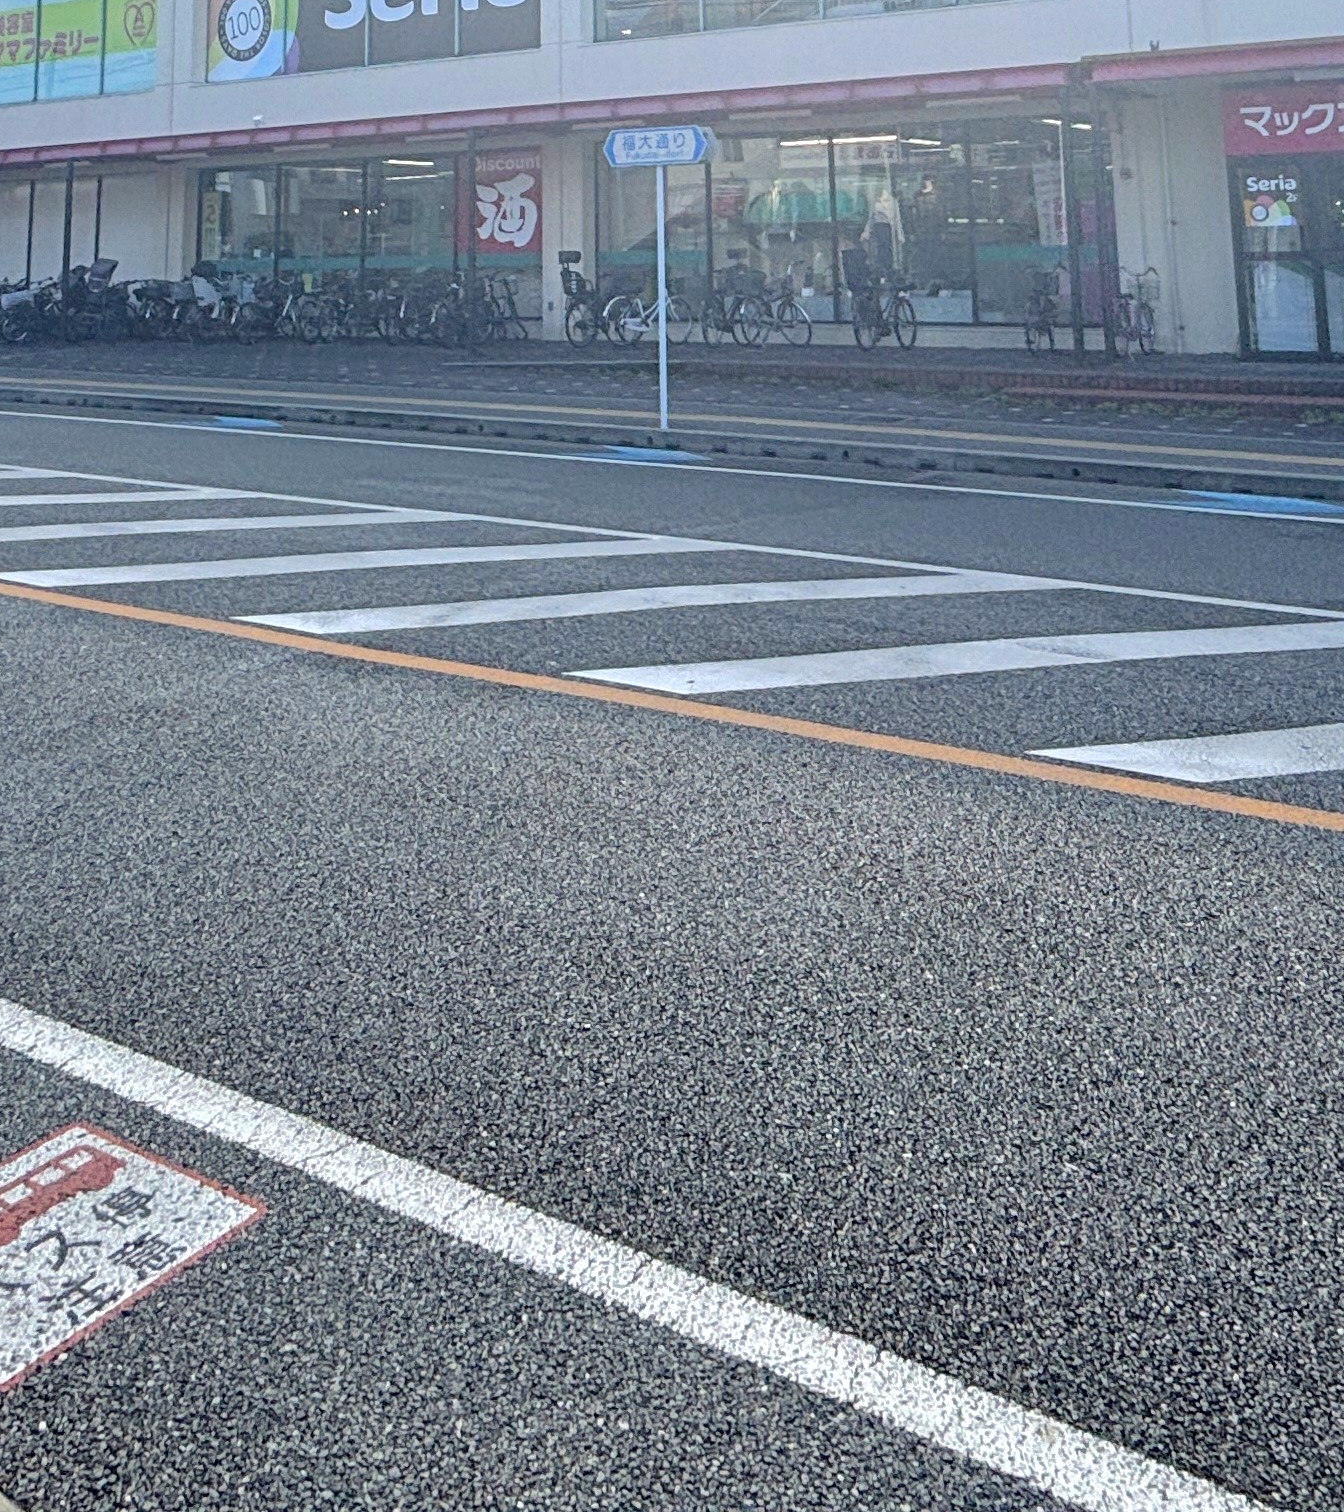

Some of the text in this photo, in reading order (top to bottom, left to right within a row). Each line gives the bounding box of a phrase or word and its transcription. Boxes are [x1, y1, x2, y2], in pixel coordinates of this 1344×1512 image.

[227, 6, 261, 40] 100
[622, 132, 686, 151] 福大通り
[1246, 175, 1297, 192] Seria
[475, 172, 538, 248] 酒
[39, 1233, 188, 1326] 注意
